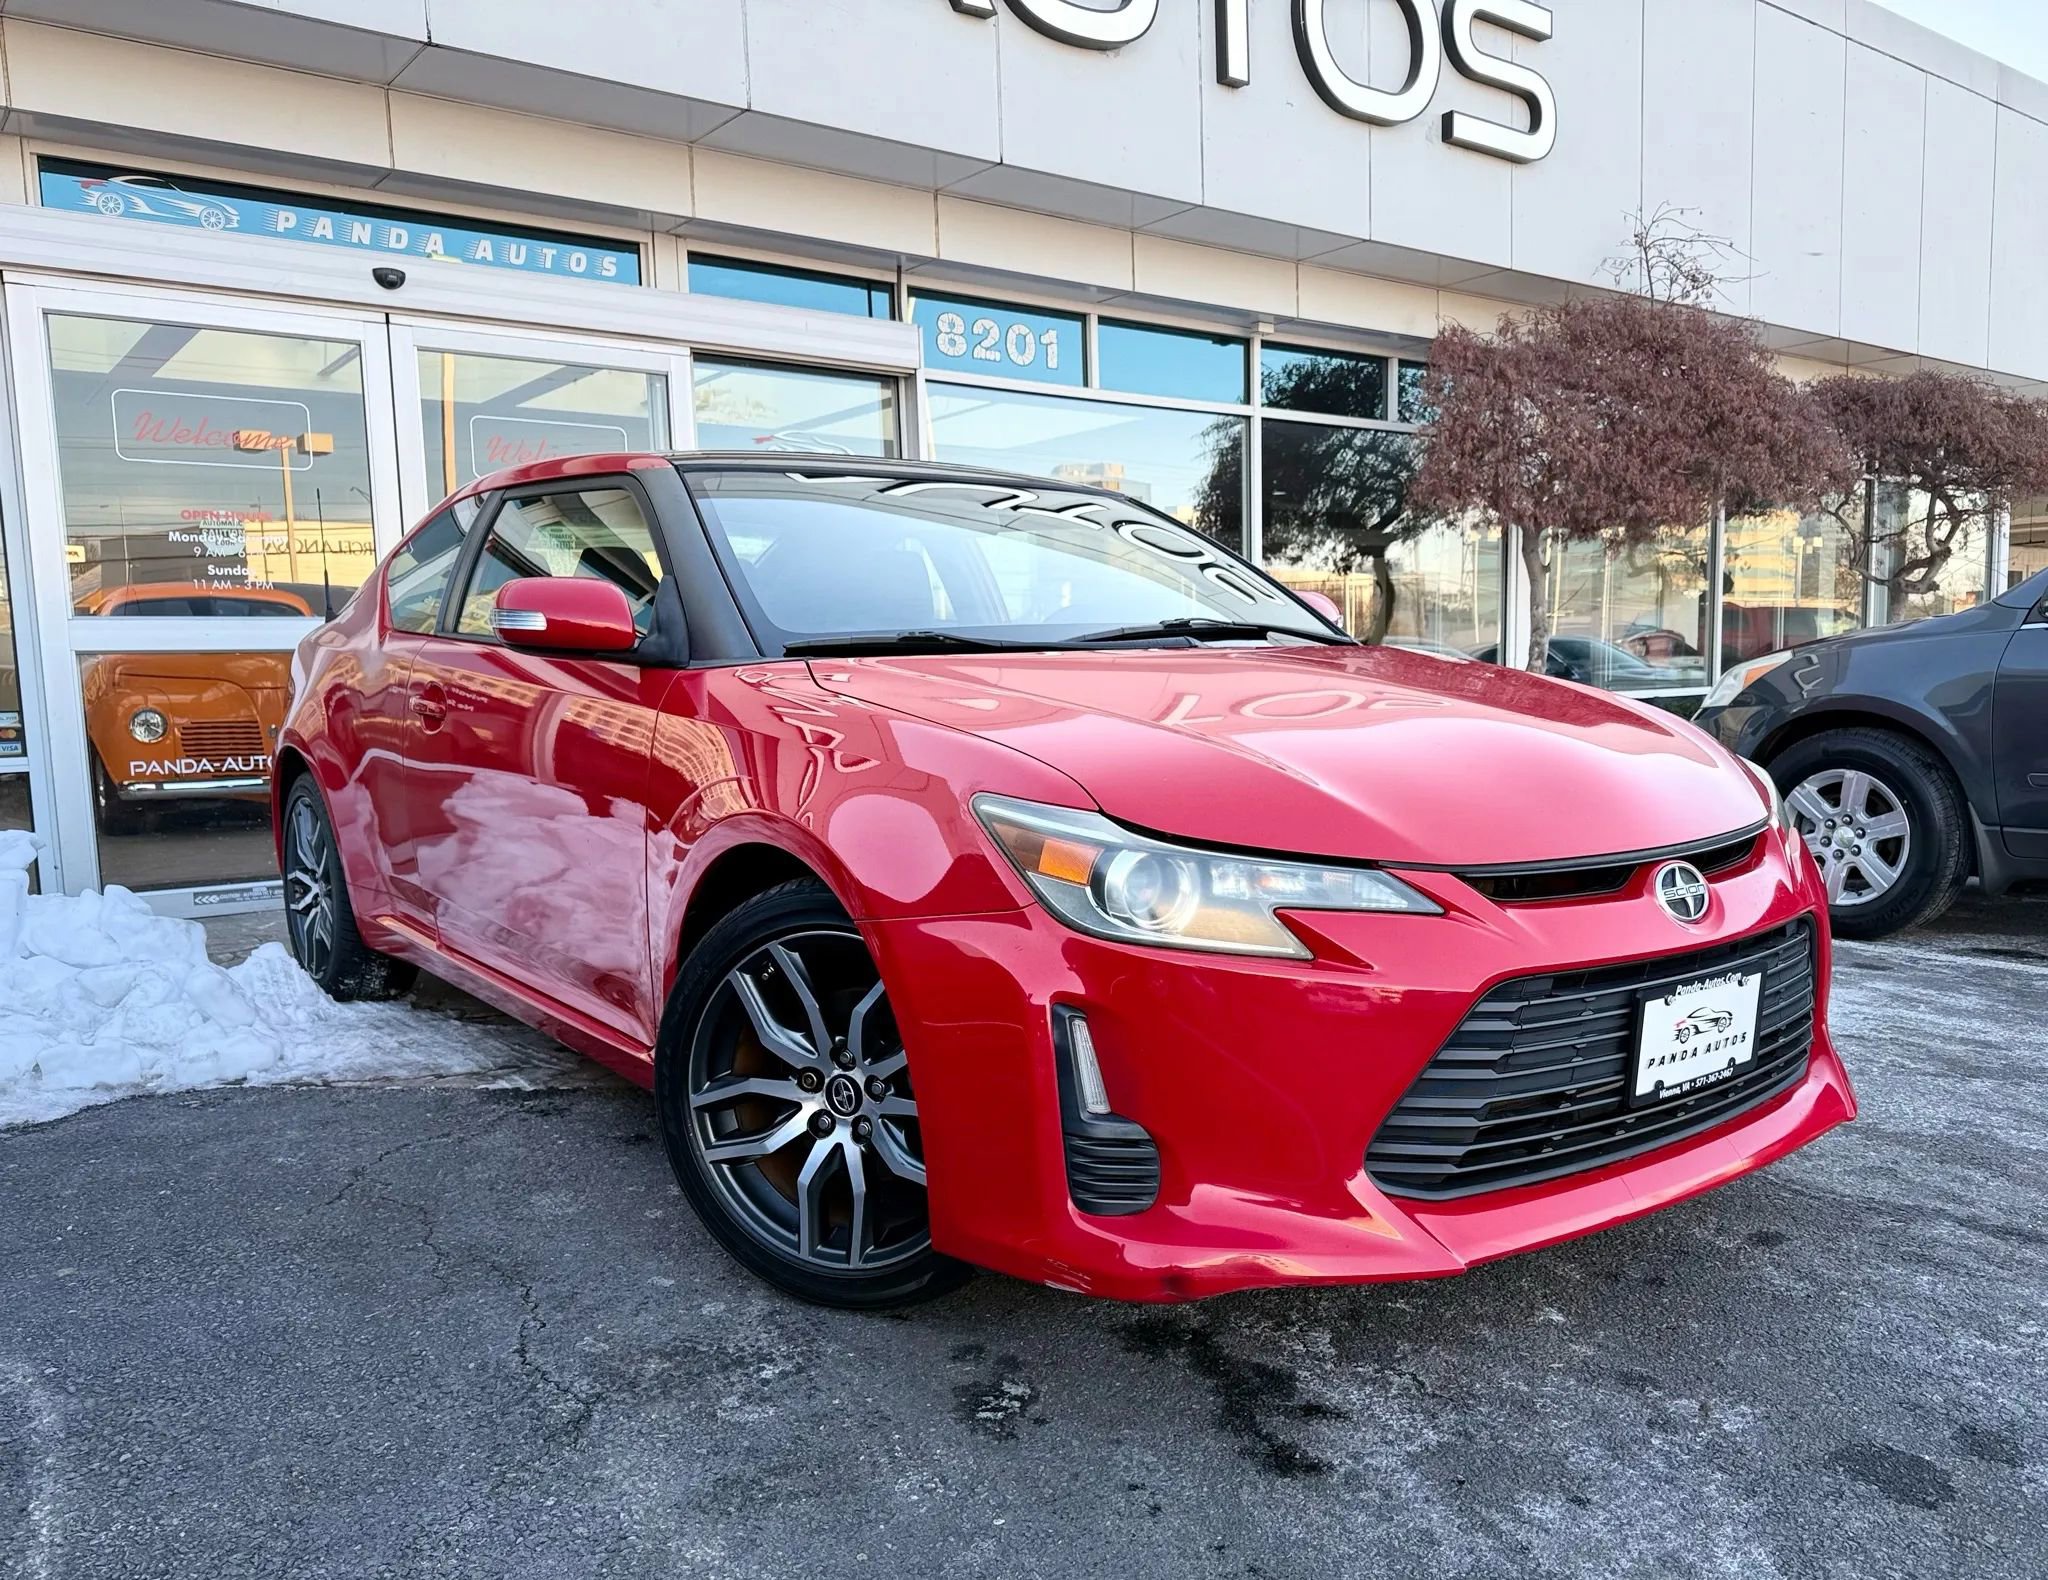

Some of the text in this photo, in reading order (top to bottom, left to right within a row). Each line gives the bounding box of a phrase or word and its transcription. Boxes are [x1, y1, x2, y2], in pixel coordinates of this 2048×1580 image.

[276, 210, 617, 278] PANDA AUTOS
[936, 311, 1058, 370] 8201
[133, 409, 294, 449] Welcome
[193, 579, 206, 590] 11
[212, 579, 232, 590] AM
[244, 579, 252, 590] 3
[256, 579, 274, 591] PM
[207, 564, 257, 579] Sunda
[1663, 883, 1706, 899] SCION
[1647, 1031, 1748, 1069] PANDA AUTOS
